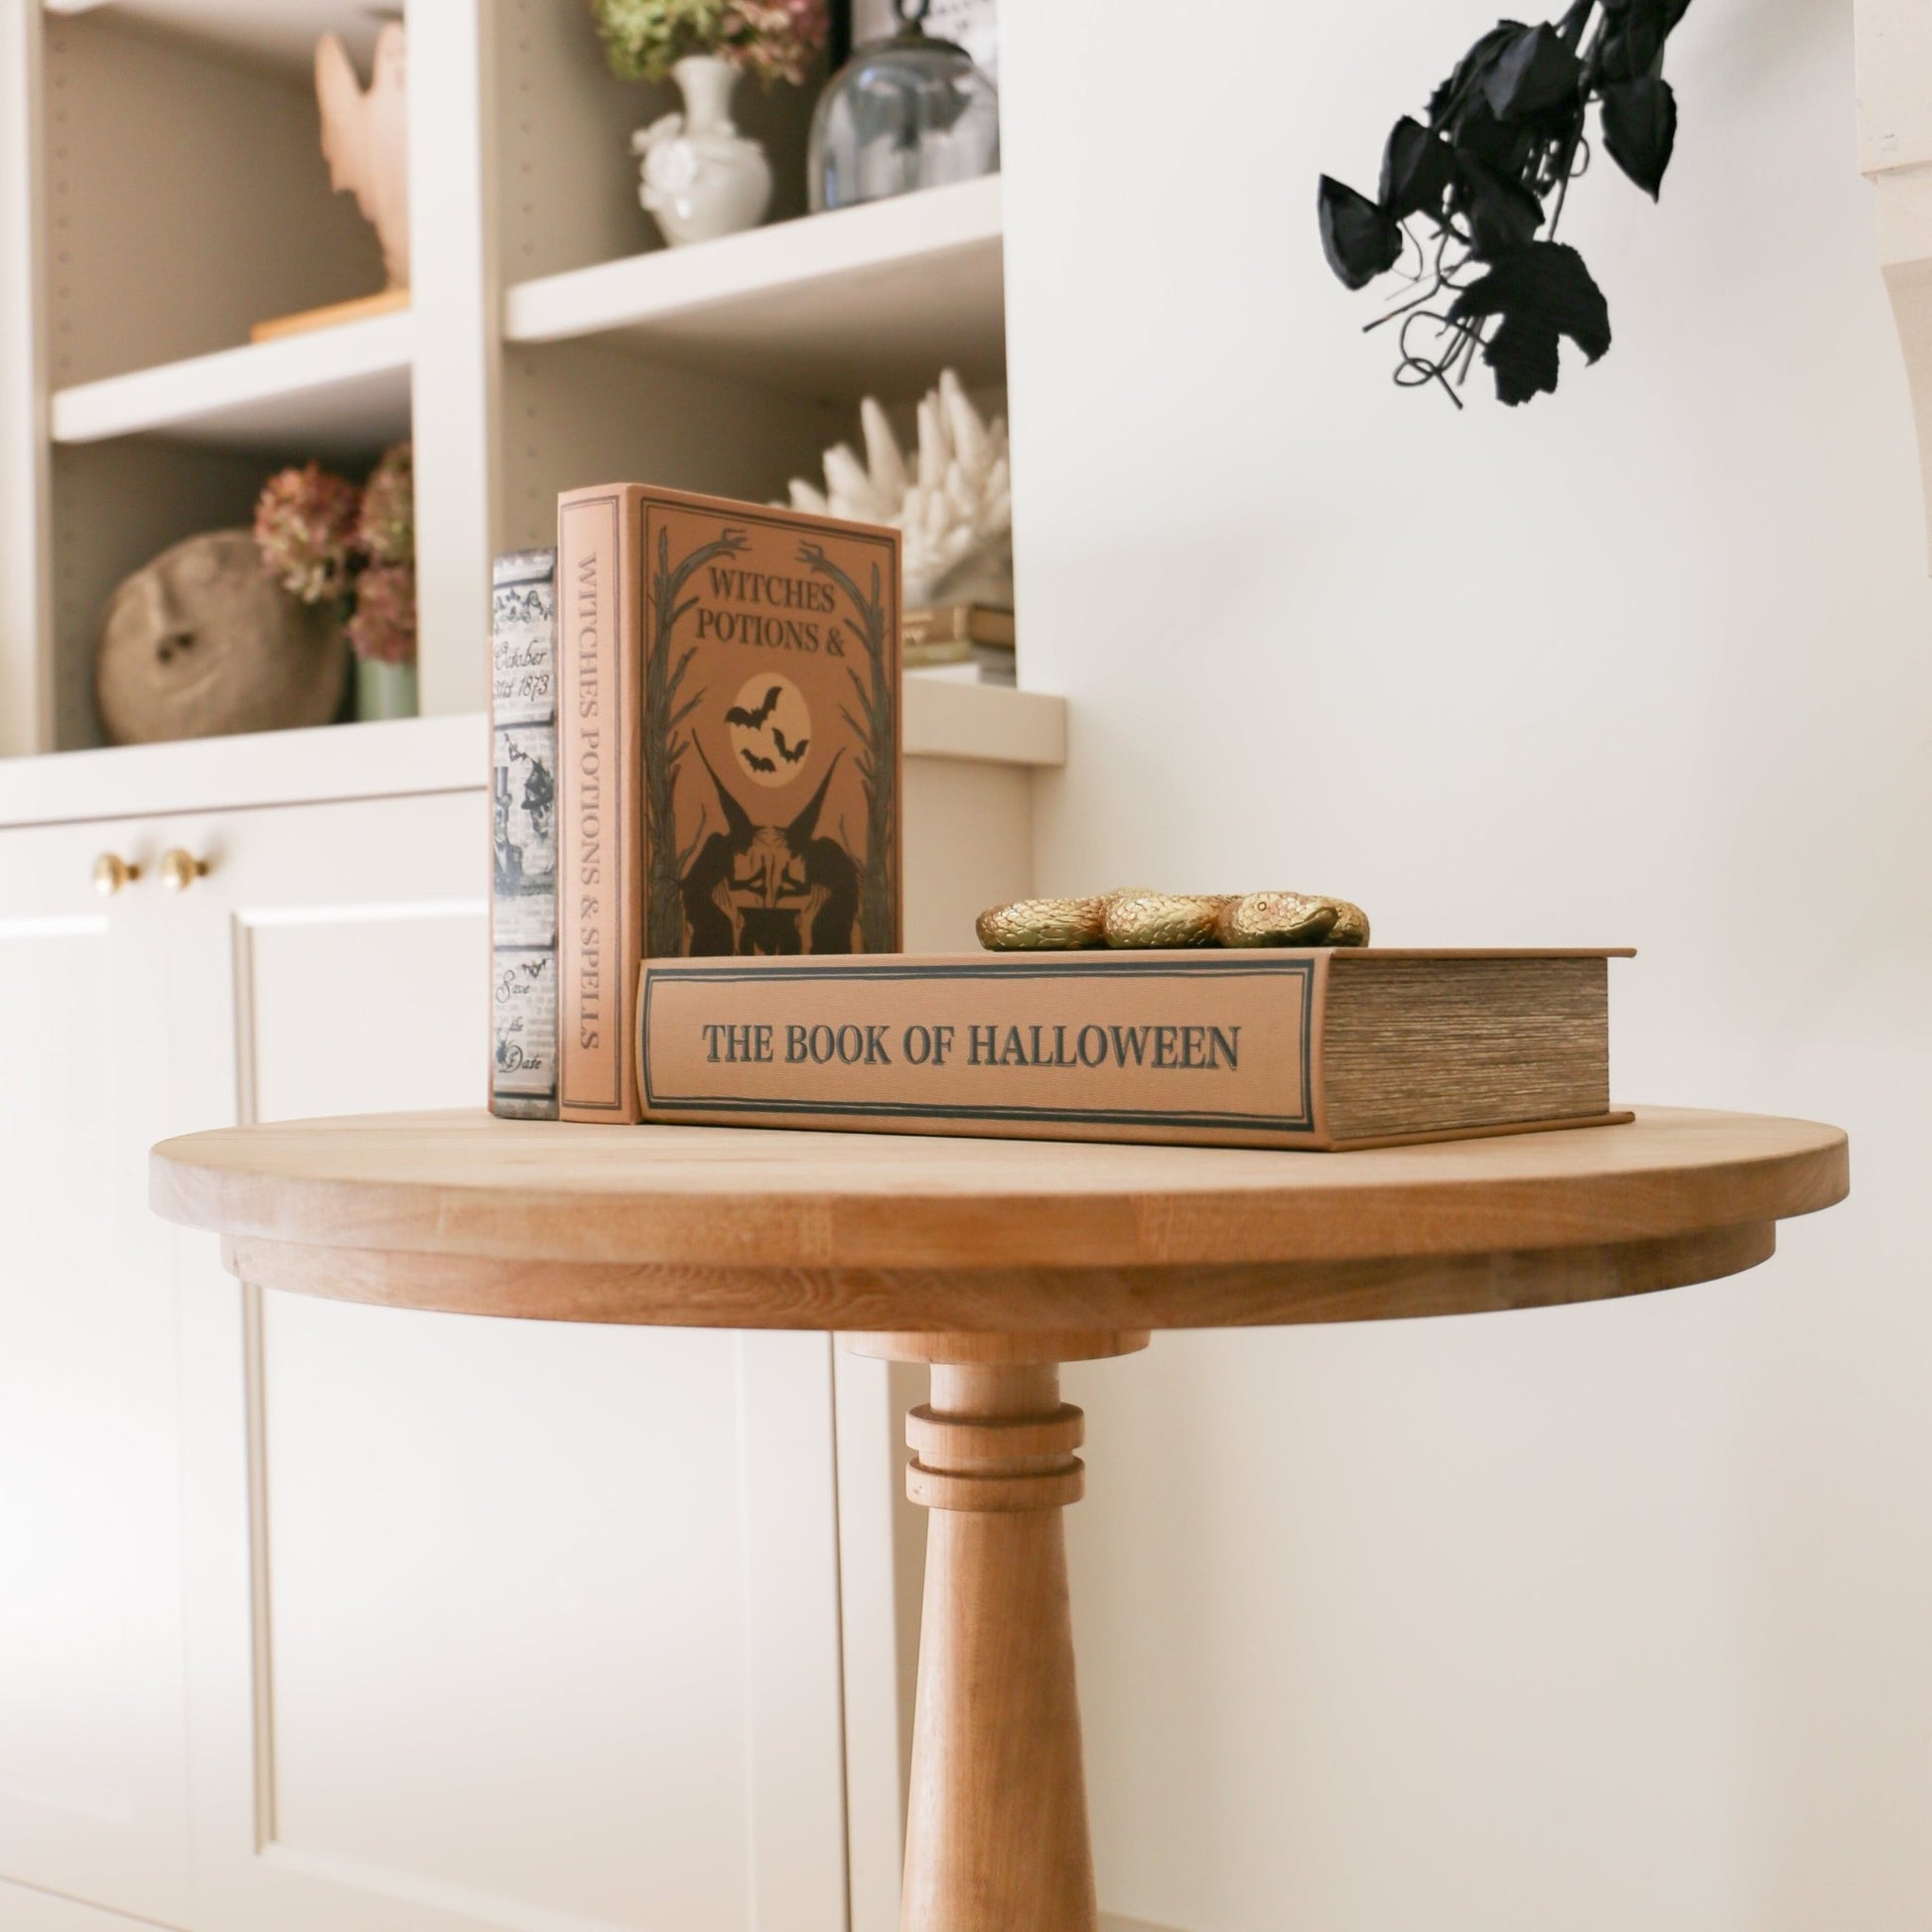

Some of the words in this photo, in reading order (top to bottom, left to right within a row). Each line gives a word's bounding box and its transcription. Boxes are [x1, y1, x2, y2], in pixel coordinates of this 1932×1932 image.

[708, 566, 836, 613] WITCHES
[578, 552, 598, 719] WITCHES
[696, 608, 819, 652] POTIONS
[826, 626, 845, 657] &
[518, 674, 549, 702] 1873
[581, 728, 600, 885] POTIONS
[581, 897, 600, 919] &
[581, 927, 600, 1049] SPELLS
[702, 1024, 773, 1063] THE
[783, 1025, 892, 1065] BOOK
[902, 1026, 954, 1066] OF
[967, 1025, 1241, 1071] HALLOWEEN
